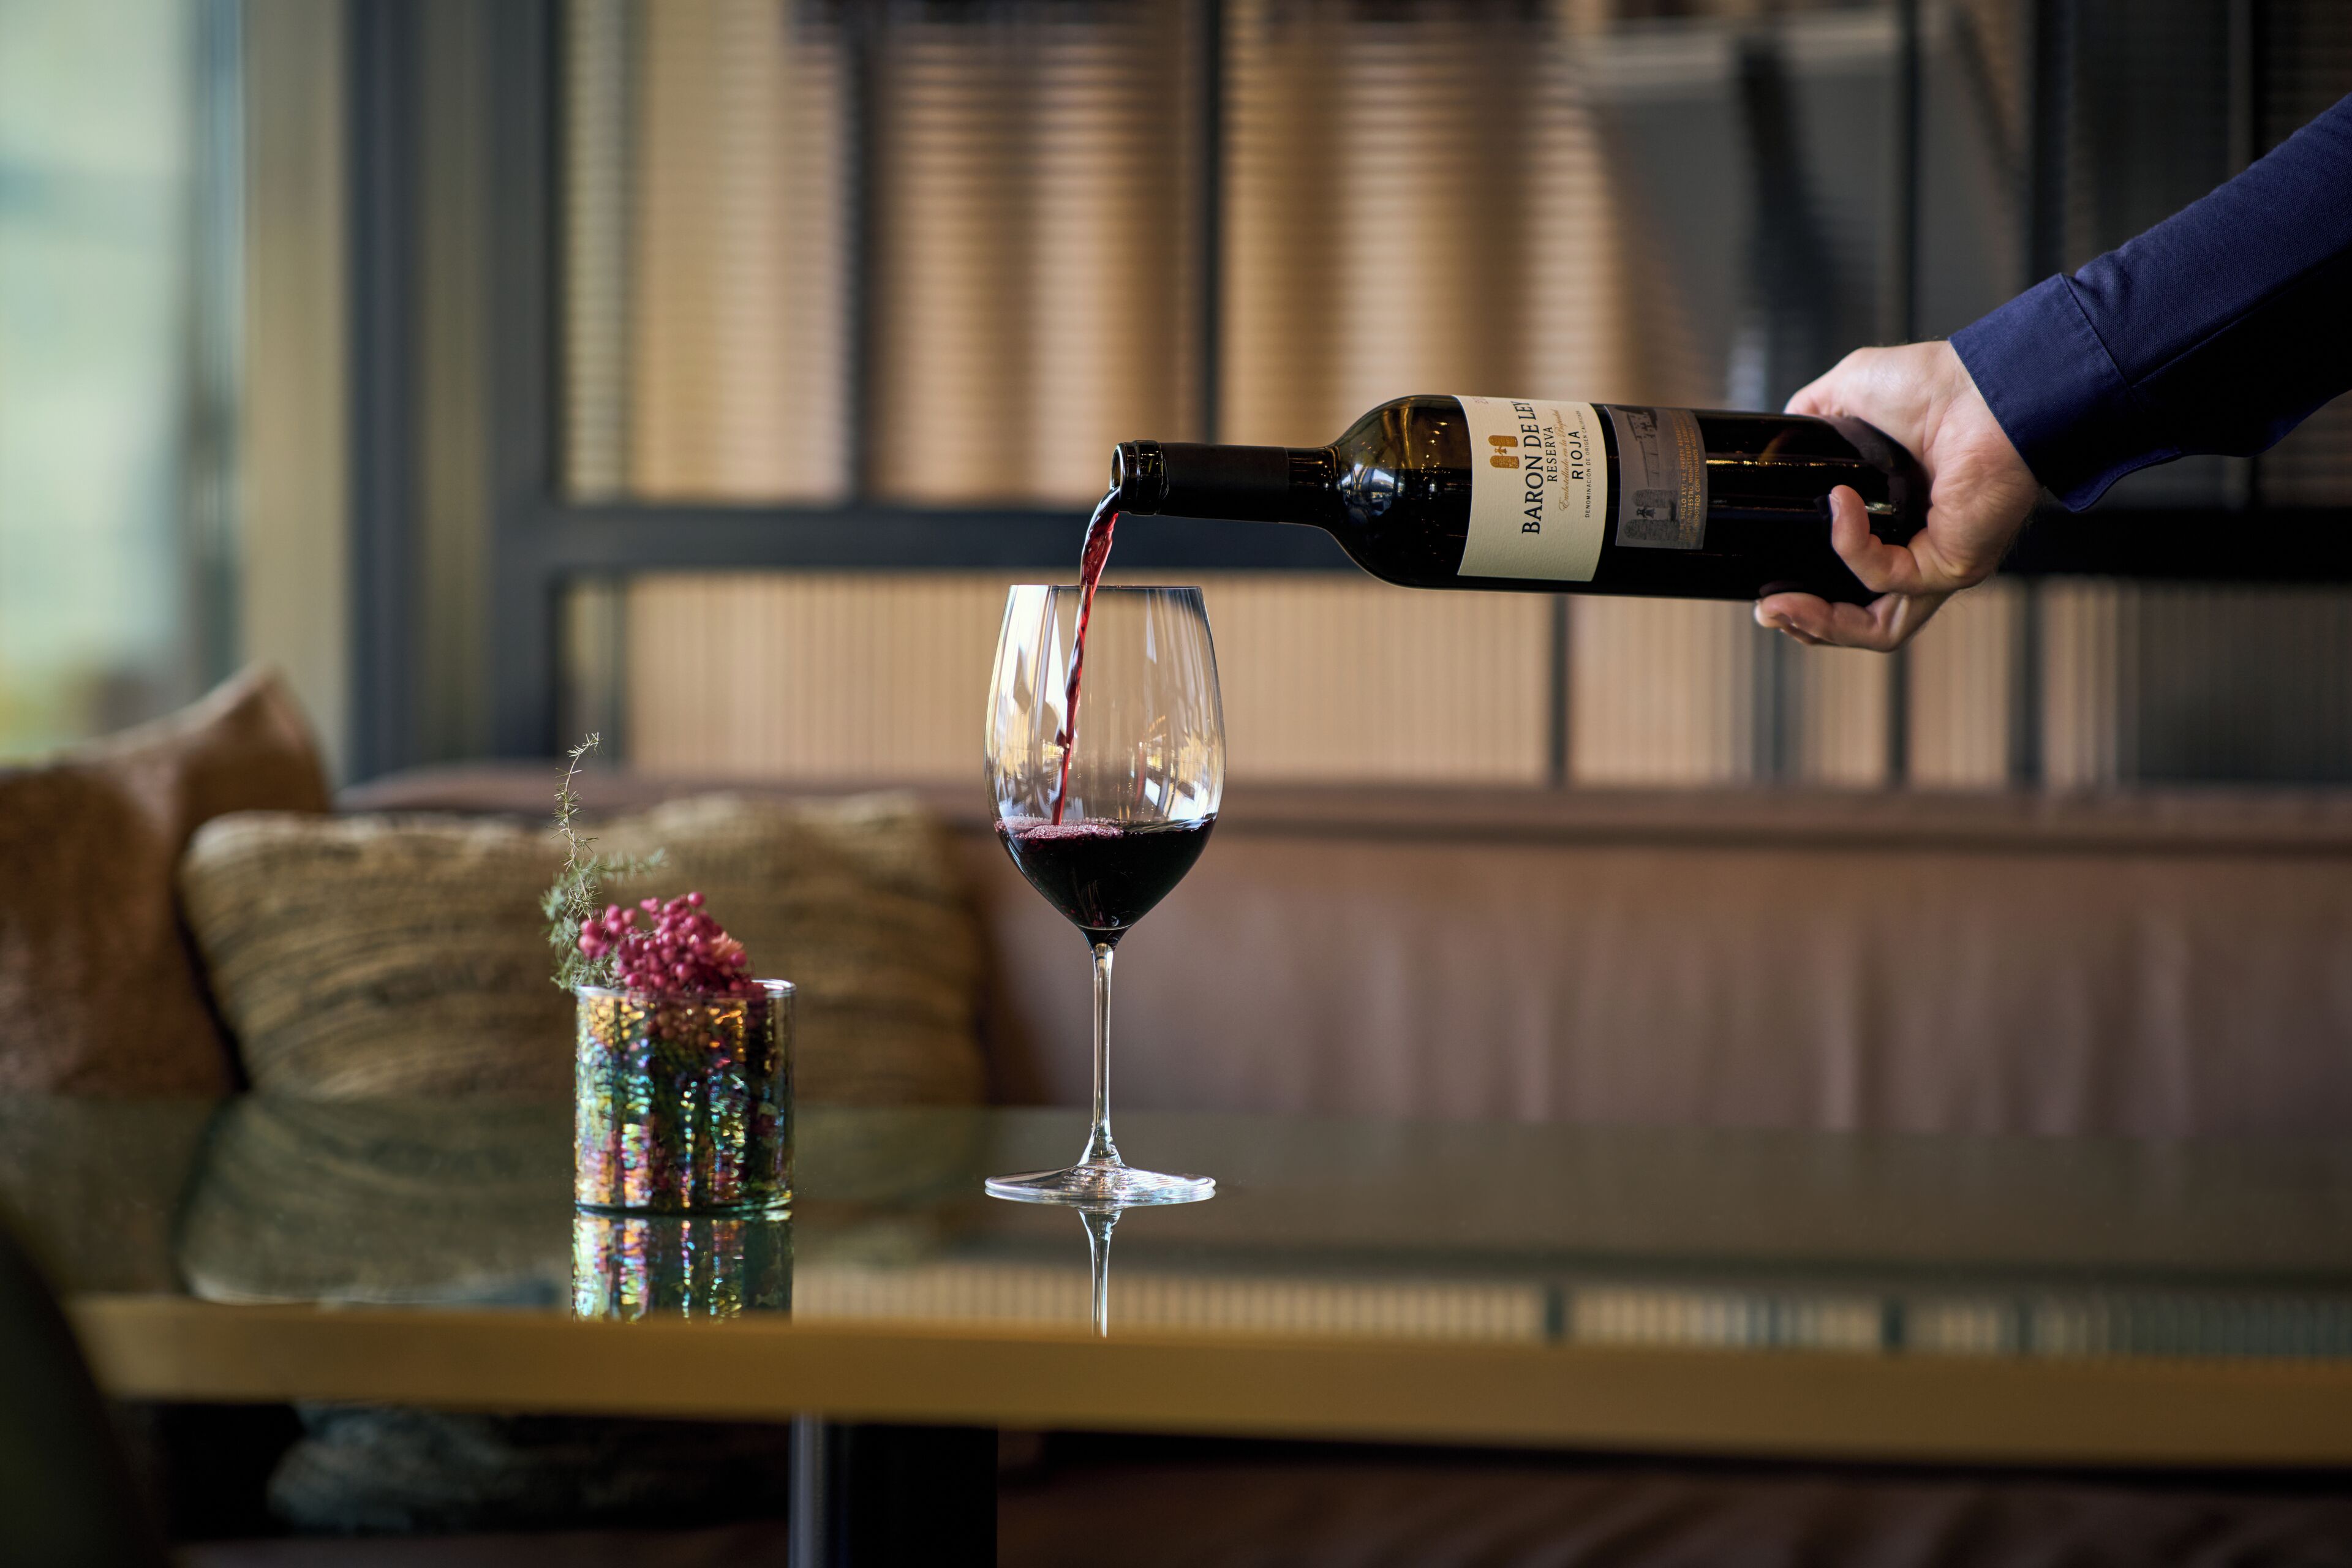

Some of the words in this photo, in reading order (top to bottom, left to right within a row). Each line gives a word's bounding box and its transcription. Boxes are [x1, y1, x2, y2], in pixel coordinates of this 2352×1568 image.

[1510, 401, 1537, 421] LEY
[1521, 424, 1542, 448] DE
[1543, 427, 1558, 483] RESERVA
[1562, 448, 1568, 457] en
[1568, 431, 1584, 480] RIOJA
[1558, 459, 1570, 511] Embotellado
[1685, 445, 1694, 483] MONASTERIO
[1521, 454, 1544, 535] BARON
